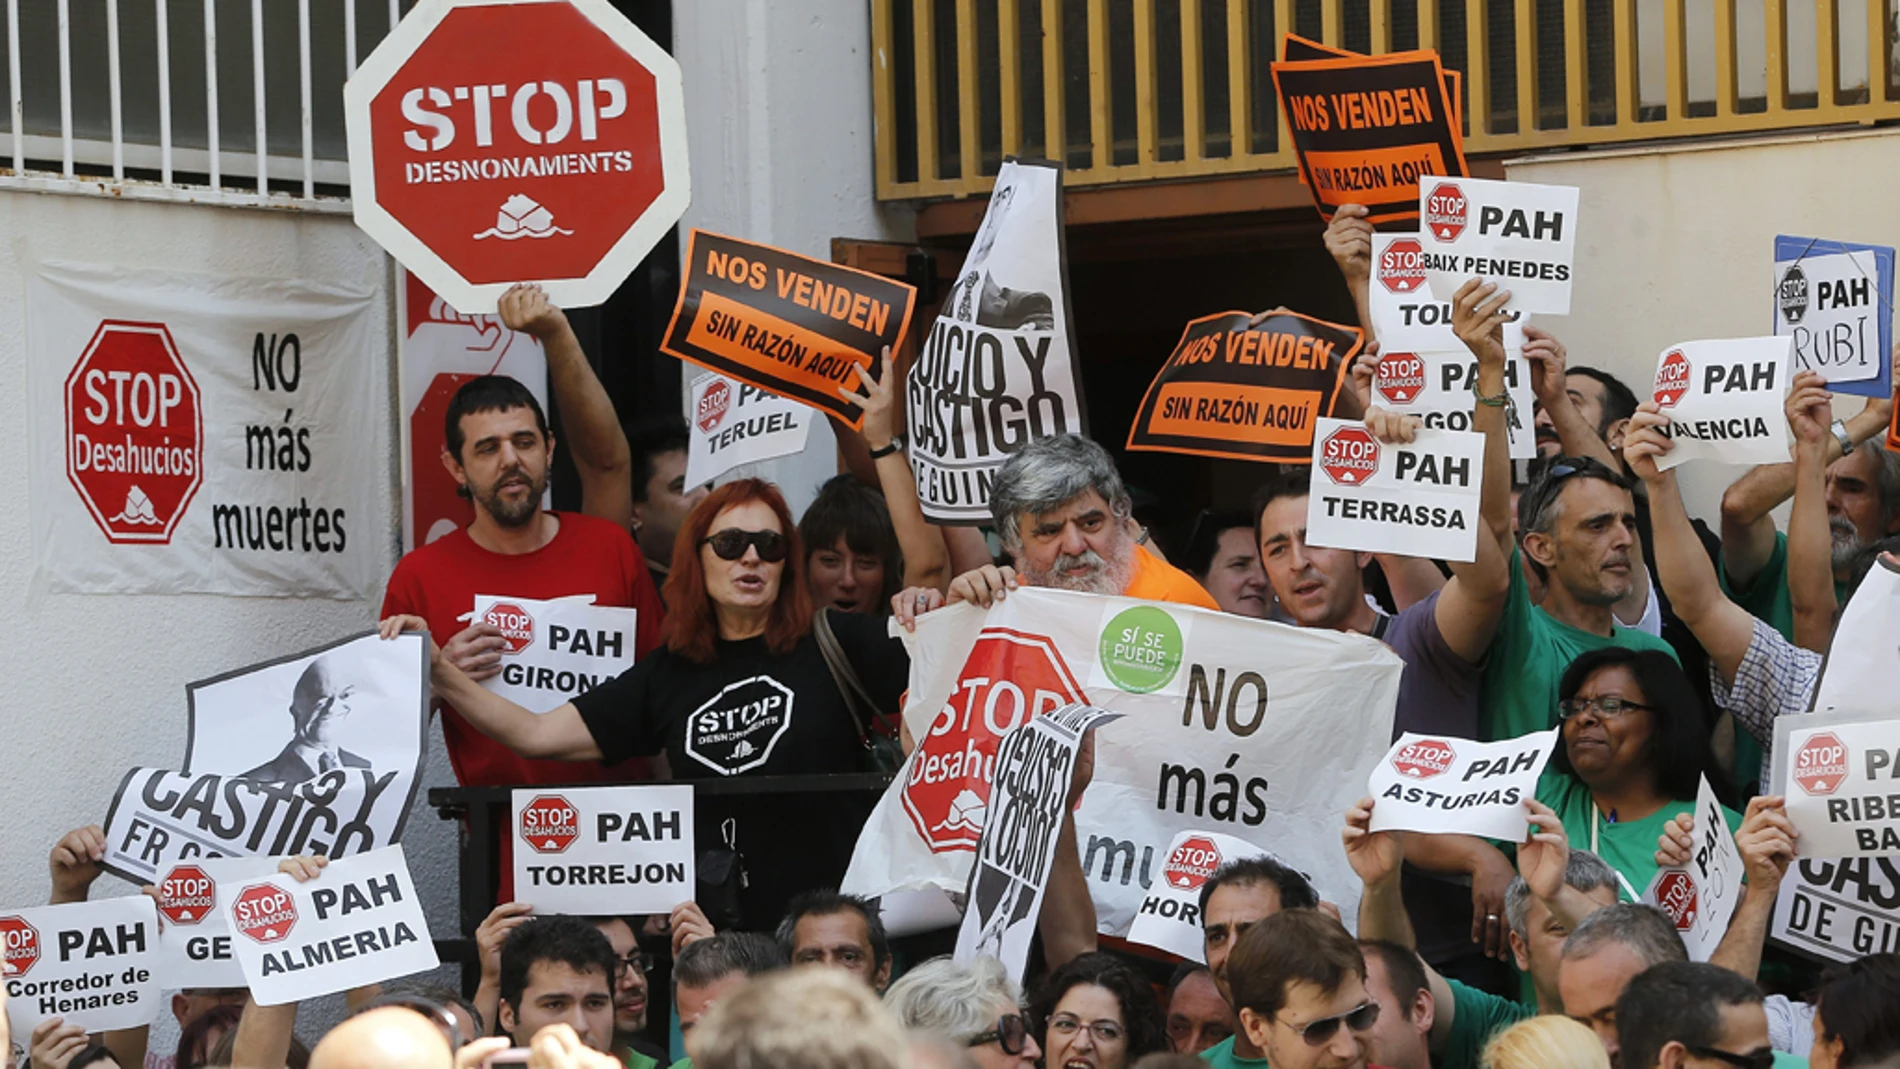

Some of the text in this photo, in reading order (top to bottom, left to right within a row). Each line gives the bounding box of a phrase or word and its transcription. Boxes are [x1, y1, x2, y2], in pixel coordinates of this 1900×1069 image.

[401, 78, 627, 151] STOP
[1290, 86, 1433, 132] NOS VENDEN
[406, 150, 632, 184] DESNONAMENTS
[1315, 154, 1435, 191] SIN RAZÓN AQUÍ
[1430, 196, 1465, 215] STOP
[1479, 205, 1563, 241] PAH
[1424, 251, 1570, 281] BAIX PENEDES
[706, 250, 890, 337] NOS VENDEN
[1782, 279, 1806, 298] STOP
[1818, 277, 1869, 310] PAH
[706, 310, 857, 384] SIN RAZÓN AQUÍ
[1174, 329, 1335, 371] NOS VENDEN
[1794, 316, 1868, 370] RUBI
[253, 332, 301, 392] NO
[909, 322, 1052, 399] UICIO Y
[1380, 360, 1420, 378] STOP
[1703, 362, 1776, 394] PAH
[84, 369, 182, 427] STOP
[700, 387, 728, 413] STOP
[1163, 394, 1309, 430] SIN RAZÓN AQUÍ
[708, 412, 798, 454] TERUEL
[909, 379, 1067, 459] CASTIGO
[1653, 417, 1769, 440] VALENCIA
[75, 433, 193, 477] Desahucios
[246, 408, 311, 472] más
[1328, 439, 1374, 459] STOP
[1324, 456, 1375, 470] DESAHUCIOS
[1395, 451, 1470, 487] PAH
[212, 497, 346, 553] muertes
[1322, 496, 1466, 530] TERRASSA
[487, 612, 530, 630] STOP
[1121, 626, 1165, 648] SÍ SE
[549, 625, 622, 658] PAH
[1113, 643, 1167, 667] PUEDE
[698, 695, 781, 733] STOP
[1182, 663, 1268, 737] NO
[1401, 745, 1450, 762] STOP
[1462, 749, 1540, 782] PAH
[1799, 746, 1843, 767] STOP
[1796, 764, 1845, 779] DESAHUCIOS
[1157, 753, 1268, 826] más
[1382, 783, 1520, 810] ASTURIAS
[524, 825, 577, 837] DESAHUCIOS
[526, 808, 574, 826] STOP
[597, 810, 681, 842] PAH
[1173, 847, 1217, 866] STOP
[1696, 802, 1720, 879] PAH
[163, 879, 209, 897] STOP
[526, 862, 685, 886] TORREJON
[237, 893, 288, 920] STOP
[311, 873, 402, 920] PAH
[1660, 875, 1689, 916] STOP
[1789, 893, 1836, 941] DE
[59, 922, 146, 962] PAH
[186, 936, 232, 960] GE
[260, 921, 418, 977] ALMERIA
[7, 967, 150, 998] Corredor de
[39, 990, 139, 1015] Henares
